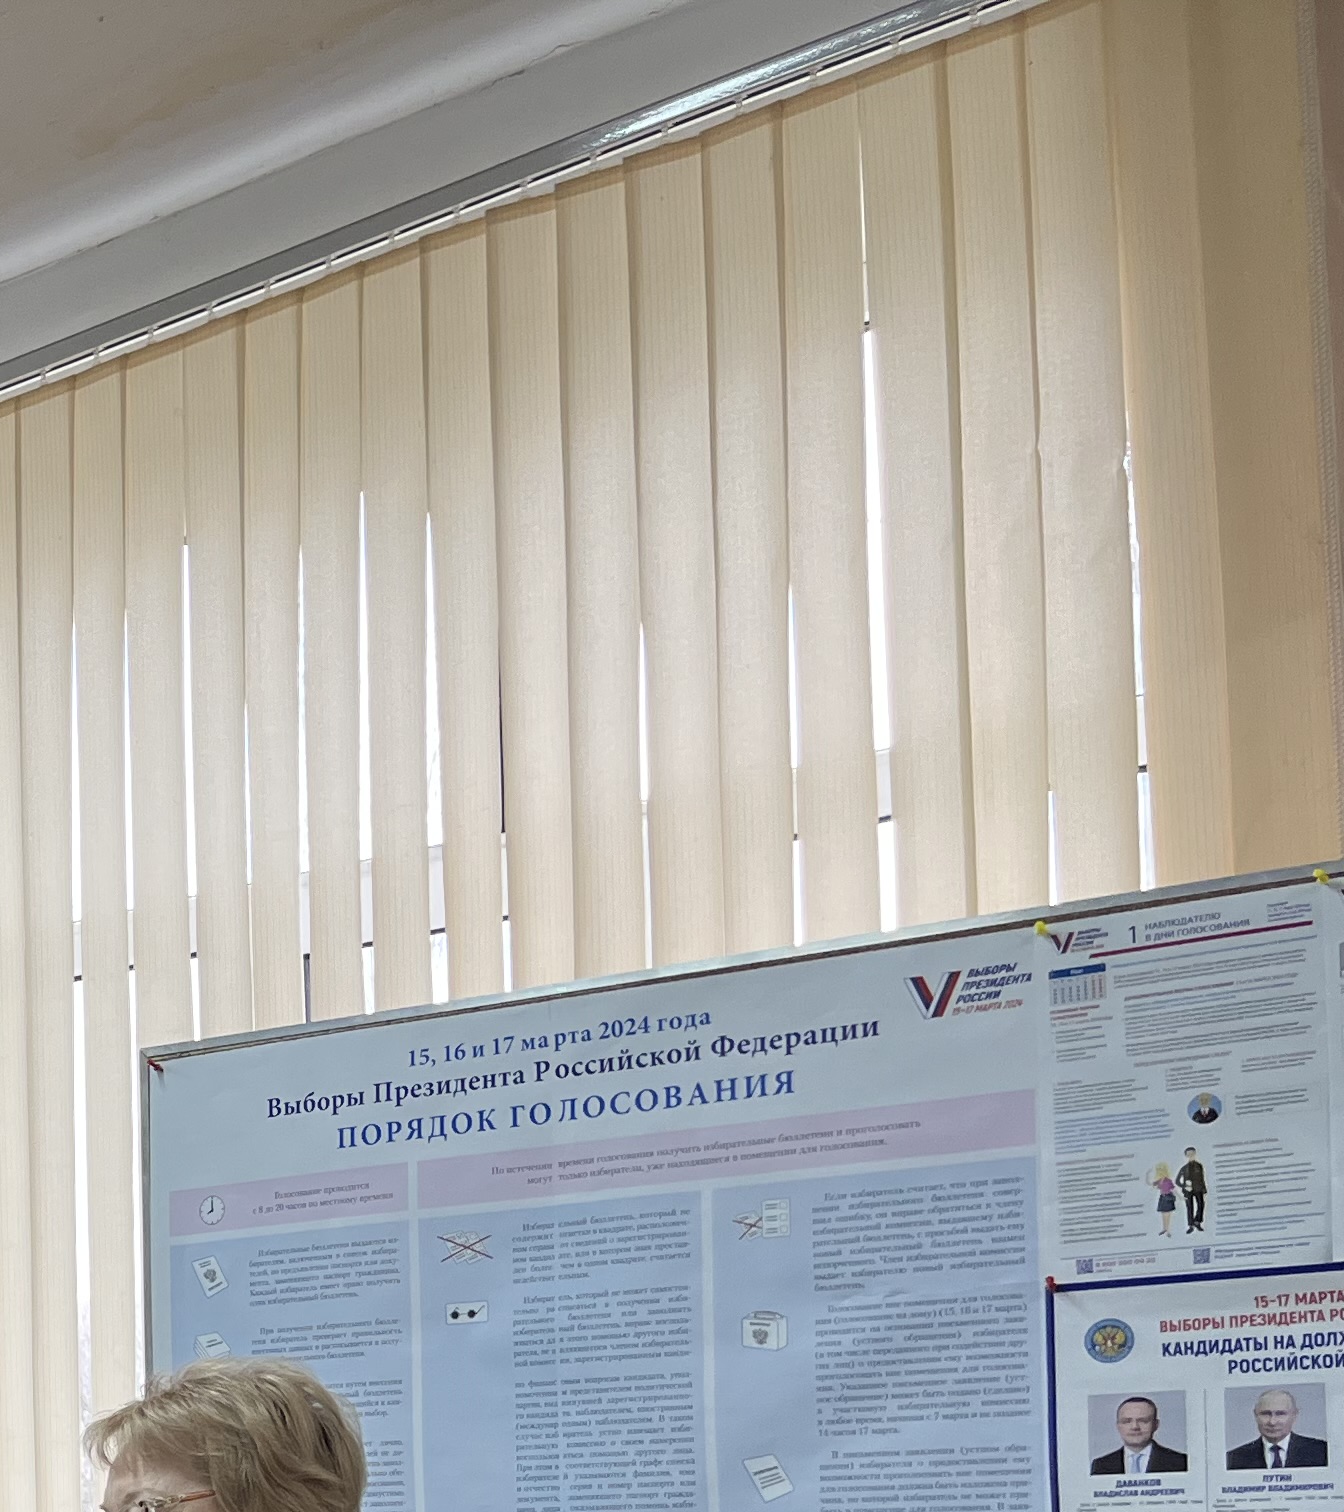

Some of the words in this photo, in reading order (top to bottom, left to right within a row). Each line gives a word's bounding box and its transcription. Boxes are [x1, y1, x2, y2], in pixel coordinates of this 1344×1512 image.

[1144, 912, 1221, 930] НАБЛЮДАТЕЛЮ
[1153, 930, 1175, 942] ДНИ
[1176, 919, 1250, 936] ГОЛОСОВАНИЯ
[1127, 924, 1138, 945] 1
[967, 962, 1017, 978] ВЫБОРЫ
[961, 972, 1032, 991] ПРЕЗИДЕНТА
[955, 989, 1002, 1004] РОССИИ
[408, 1048, 436, 1067] 15,
[444, 1042, 466, 1062] 16
[472, 1044, 485, 1058] и
[492, 1036, 516, 1055] 17
[520, 1029, 593, 1050] марта
[598, 1016, 650, 1040] 2024
[657, 1012, 710, 1031] года
[267, 1091, 364, 1118] Выборы
[374, 1070, 524, 1106] Президента
[535, 1040, 700, 1082] Российской
[711, 1021, 878, 1057] Федерации
[338, 1109, 495, 1148] ПОРЯДОК
[511, 1071, 793, 1127] ГОЛОСОВАНИЯ
[1294, 1289, 1344, 1305] МАРТА
[1159, 1316, 1224, 1333] ВЫБОРЫ
[1229, 1309, 1325, 1328] ПРЕЗИДЕНТА
[1162, 1336, 1268, 1357] КАНДИДАТЫ
[1273, 1334, 1296, 1350] НА
[1228, 1350, 1344, 1374] РОССИЙСКОЙ
[1262, 1473, 1292, 1483] ПУТИН
